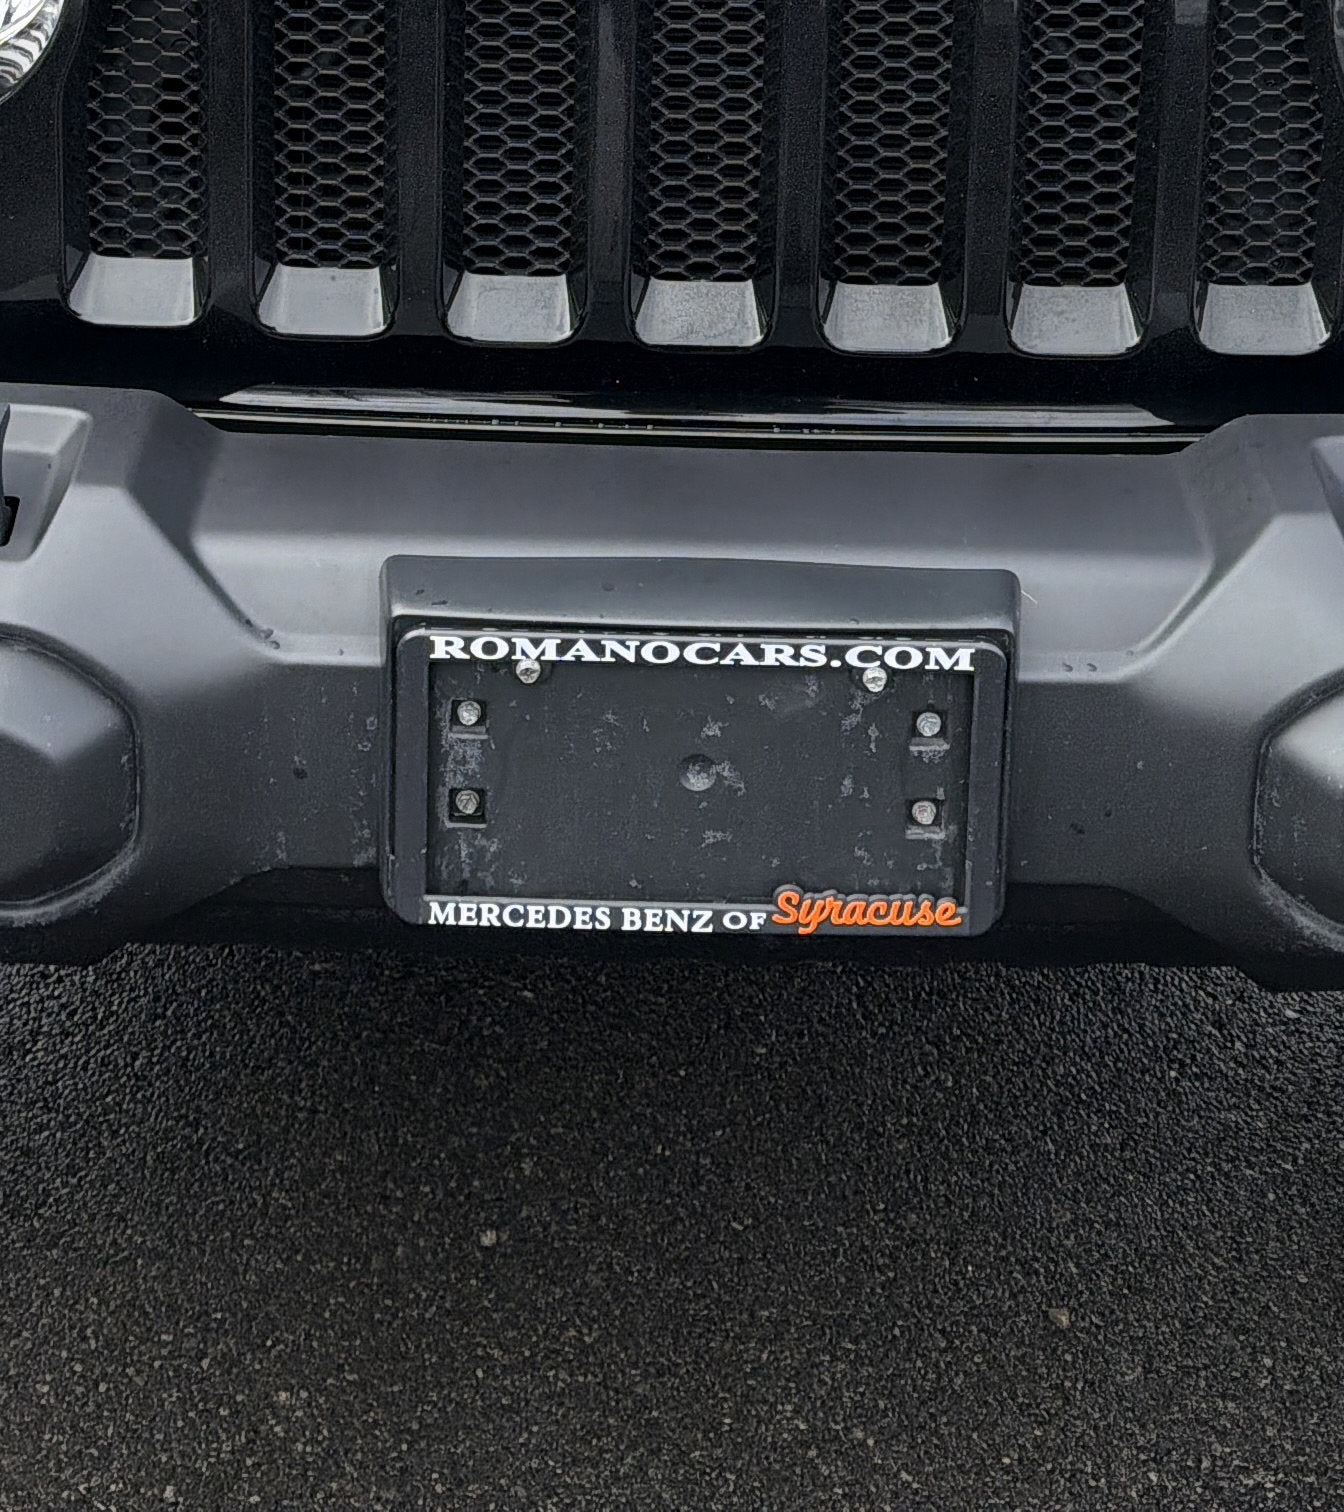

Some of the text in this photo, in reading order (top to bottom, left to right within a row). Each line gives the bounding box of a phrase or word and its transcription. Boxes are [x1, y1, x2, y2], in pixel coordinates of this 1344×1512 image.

[429, 635, 975, 672] ROMANOCARS.COM
[427, 890, 962, 935] MERCEDES BENZ OF Syracuse
